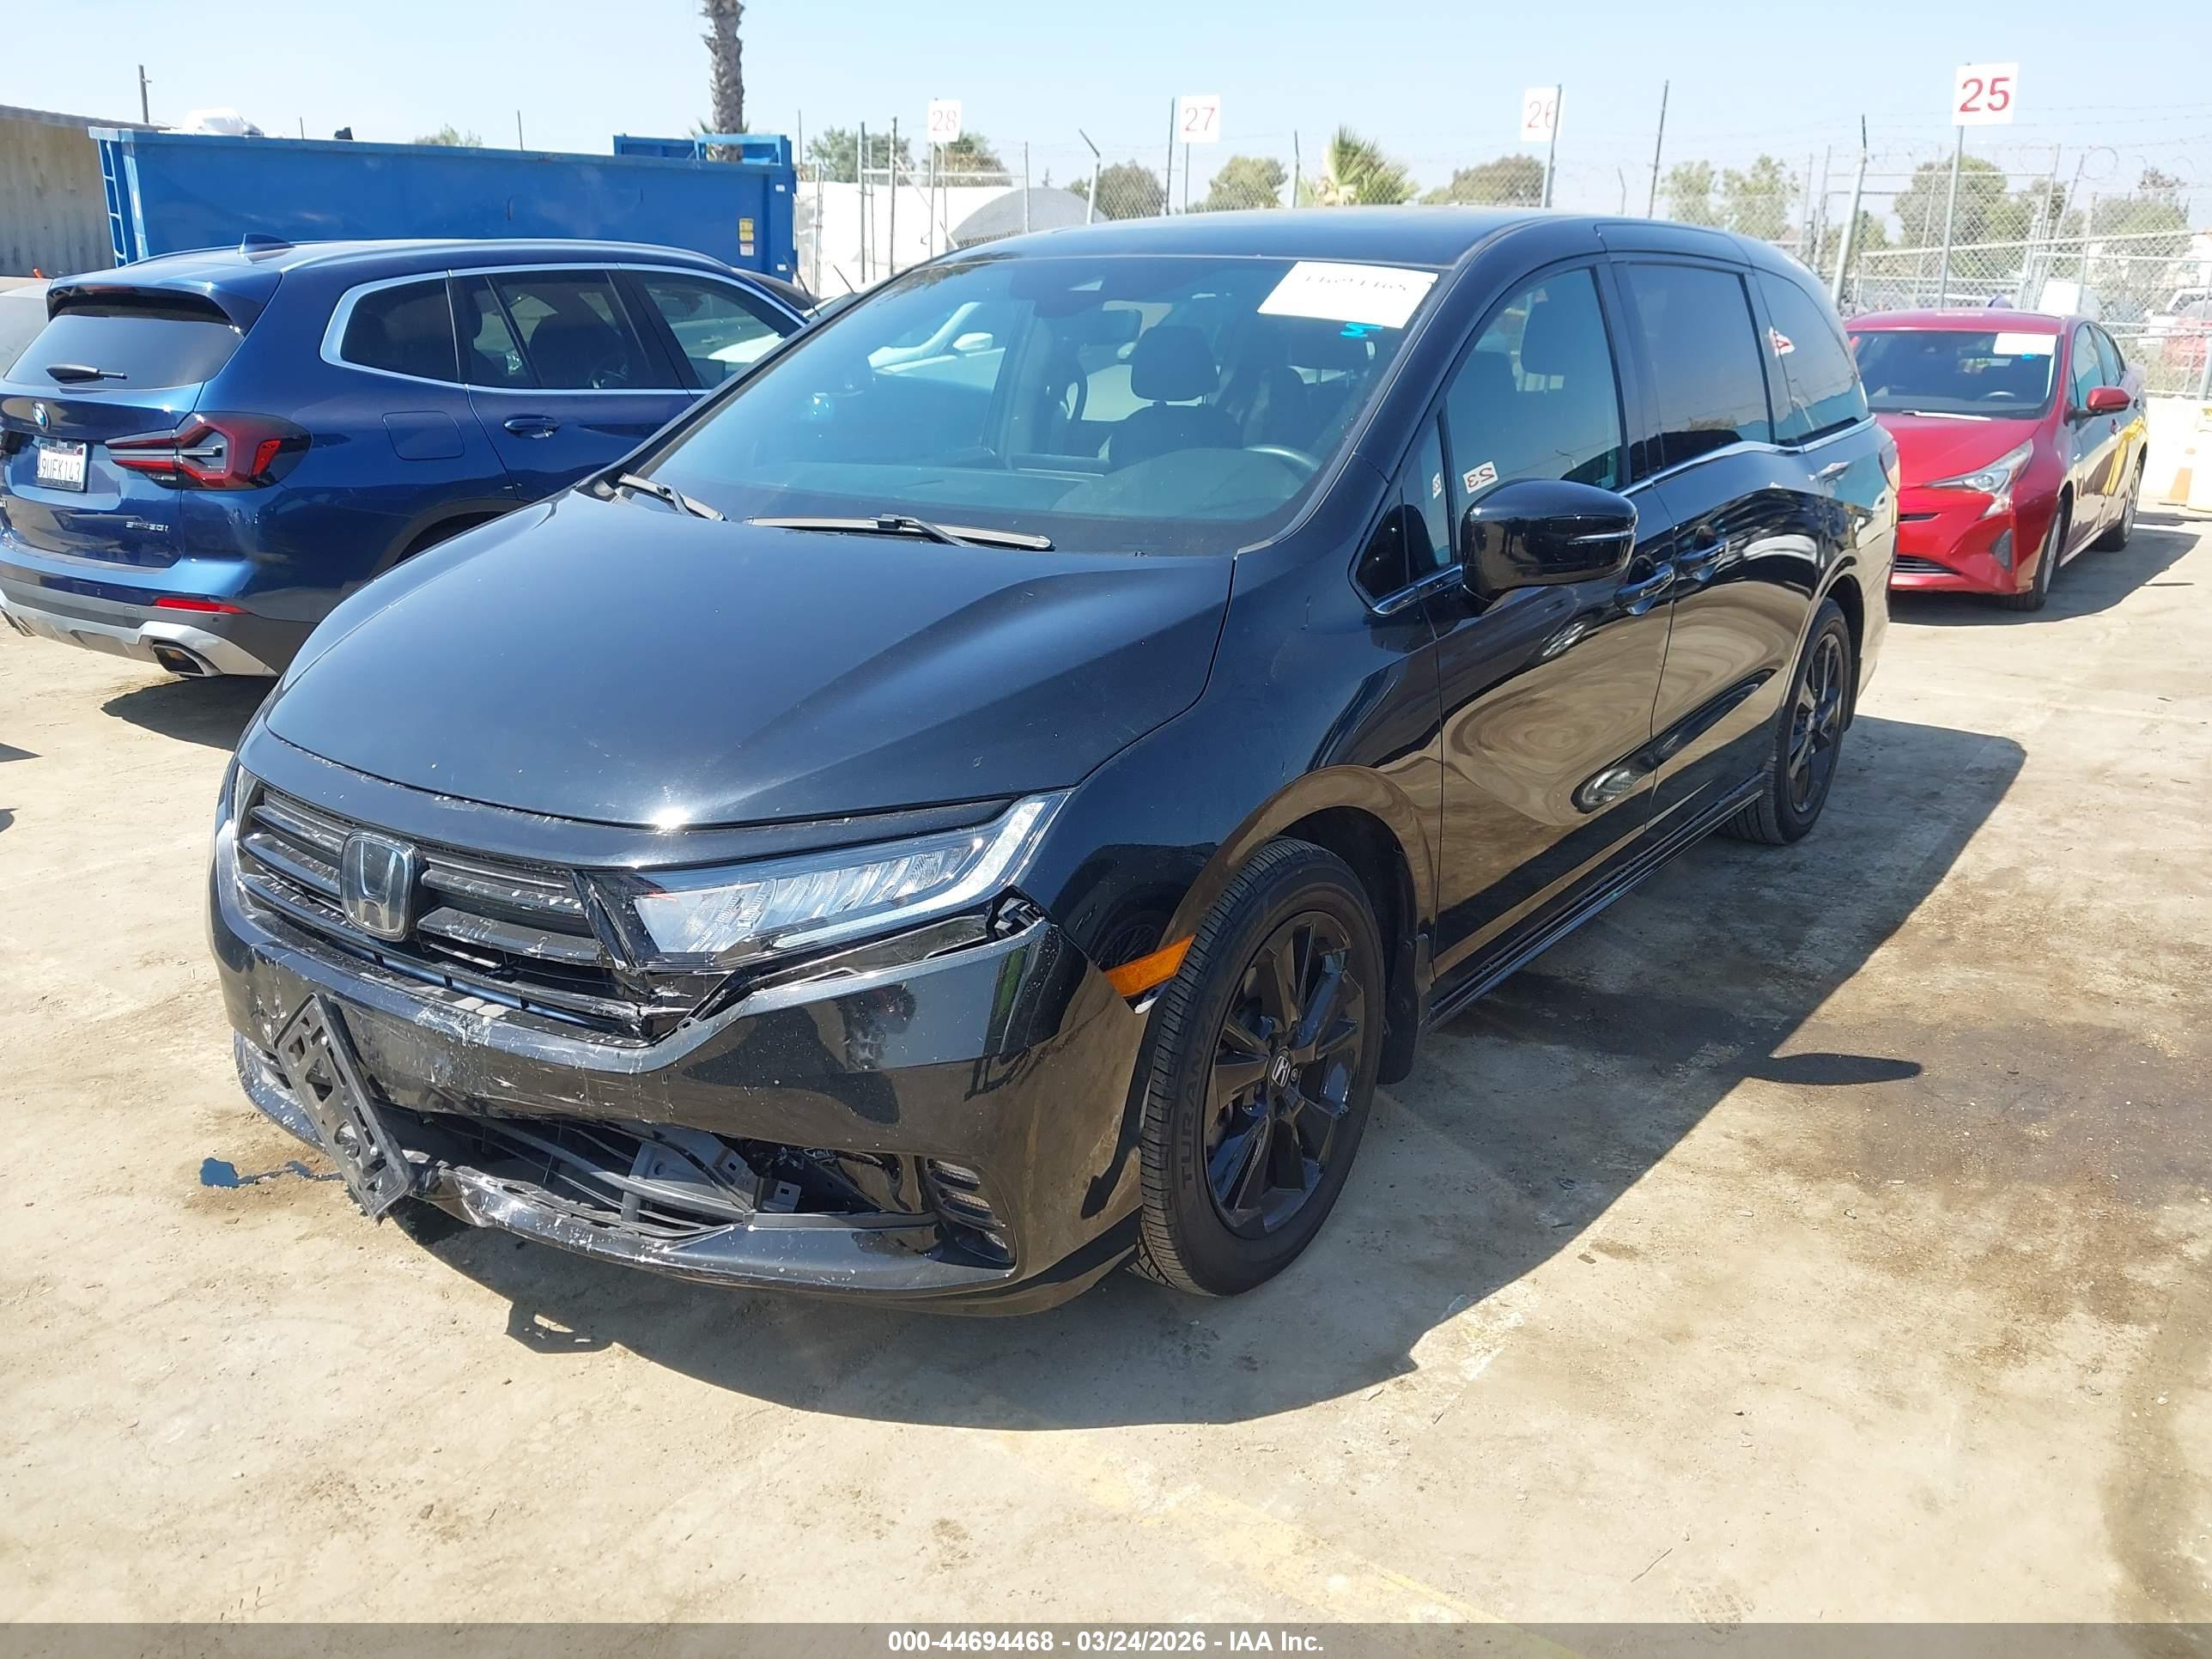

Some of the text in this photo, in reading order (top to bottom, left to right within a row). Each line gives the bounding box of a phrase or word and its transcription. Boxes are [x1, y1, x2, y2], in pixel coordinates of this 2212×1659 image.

[1959, 76, 2010, 112] 25
[932, 109, 957, 131] 28
[1185, 106, 1216, 131] 27
